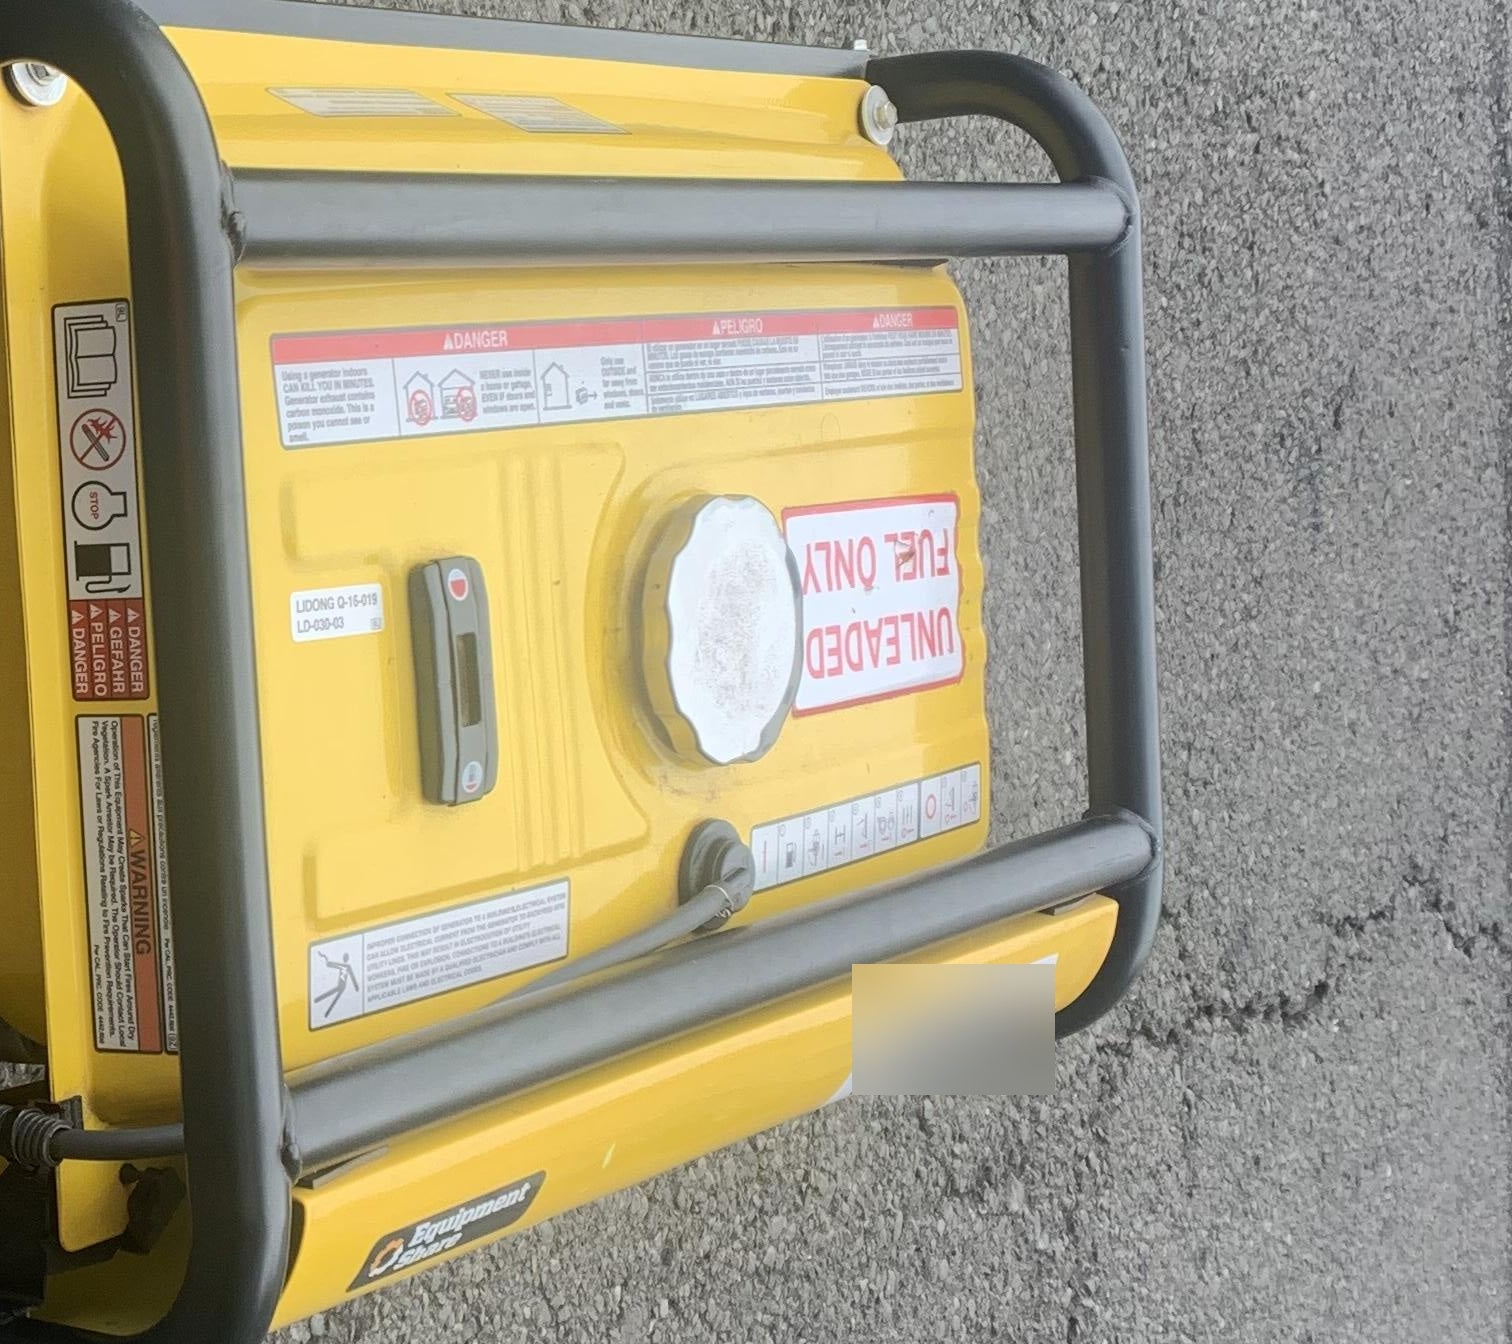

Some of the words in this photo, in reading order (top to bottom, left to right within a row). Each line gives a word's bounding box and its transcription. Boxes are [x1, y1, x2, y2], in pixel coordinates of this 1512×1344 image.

[719, 318, 762, 334] PELIGRO
[880, 313, 912, 327] DANGER
[455, 330, 508, 349] DANGER
[282, 383, 299, 393] CAN
[300, 381, 316, 392] KILL
[317, 380, 332, 390] YOU
[309, 368, 341, 380] generator
[89, 491, 100, 520] STOP
[801, 536, 876, 596] ONLY
[884, 528, 950, 583] FUEL
[296, 596, 334, 613] LIDONG
[805, 606, 954, 680] UNLEADED
[72, 628, 88, 694] DANGER
[90, 621, 108, 697] PELIGRO
[110, 626, 125, 693] GEFAHR
[128, 626, 144, 693] DANGER
[90, 721, 98, 735] Fire
[109, 720, 120, 760] Operation
[91, 738, 101, 774] Agencies
[93, 777, 102, 790] For
[103, 776, 112, 798] Spark
[112, 773, 121, 789] This
[94, 792, 103, 813] Laws
[113, 791, 124, 834] Equipment
[96, 826, 106, 872] Regulations
[106, 835, 115, 851] May
[116, 837, 125, 853] May
[117, 856, 127, 882] Create
[99, 875, 108, 906] Relating
[119, 884, 129, 912] Sparks
[129, 850, 151, 954] WARNING
[101, 919, 110, 934] Fire
[110, 908, 119, 922] The
[120, 914, 130, 931] That
[111, 925, 121, 959] Operator
[122, 934, 131, 950] Can
[102, 936, 112, 978] Prevention
[123, 952, 132, 971] Start
[114, 962, 123, 989] Should
[124, 974, 133, 992] Fires
[105, 980, 116, 1037] Requirements.
[115, 991, 125, 1023] Contact
[125, 995, 135, 1024] Around
[117, 1025, 127, 1046] Local
[127, 1026, 136, 1040] Dry
[408, 1182, 532, 1248] Equipment
[392, 1232, 464, 1271] Share
